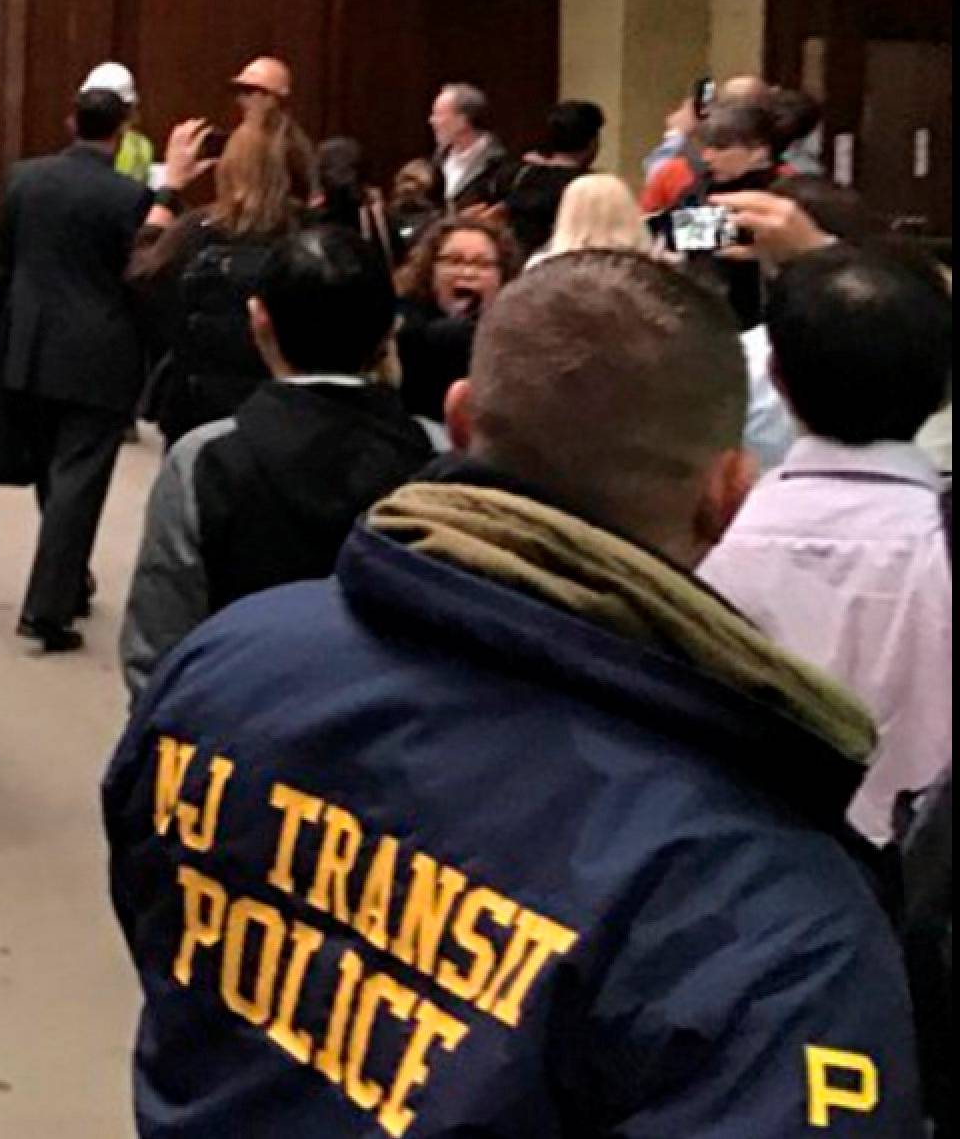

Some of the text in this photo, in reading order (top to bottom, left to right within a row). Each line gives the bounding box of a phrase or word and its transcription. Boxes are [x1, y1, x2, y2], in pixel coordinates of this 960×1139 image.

[154, 737, 578, 1027] NJ TRANSIT
[174, 866, 469, 1139] POLICE
[805, 1045, 879, 1127] P
